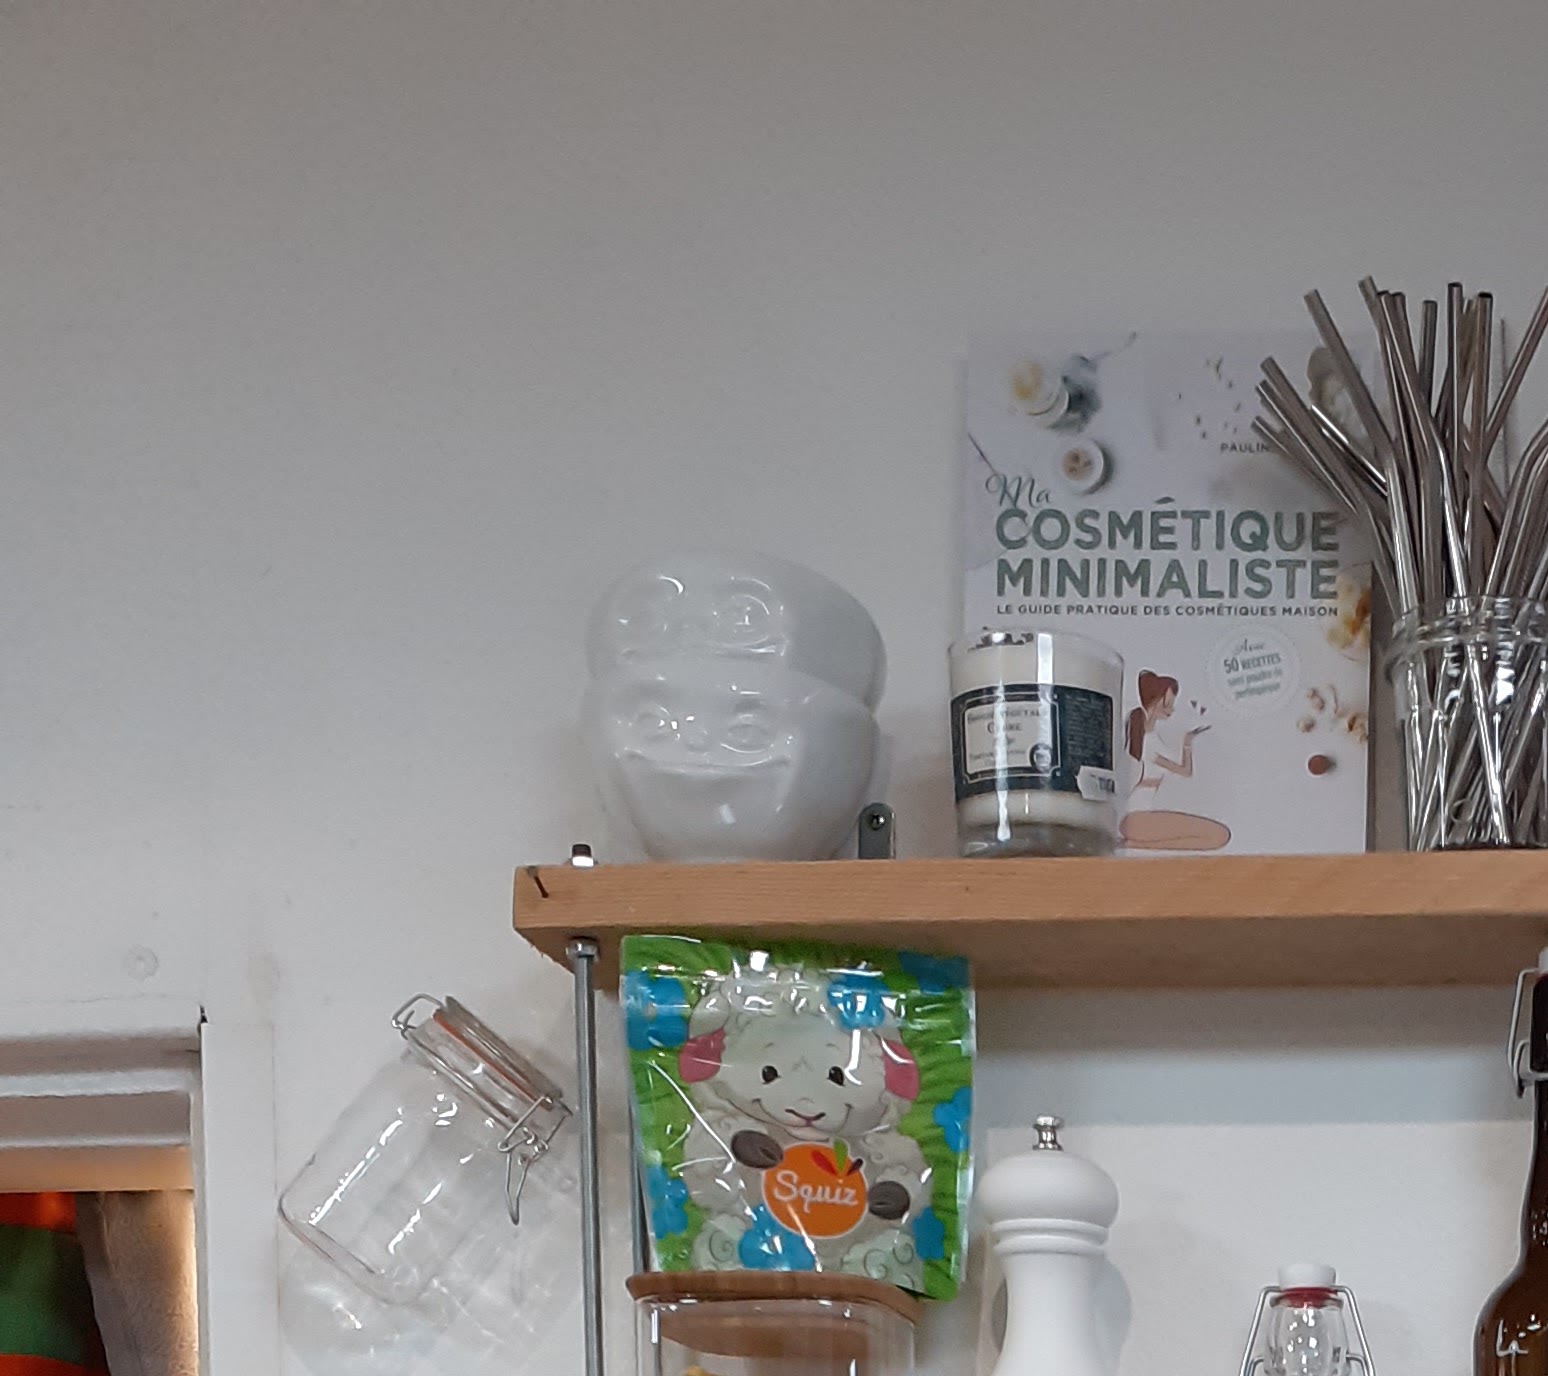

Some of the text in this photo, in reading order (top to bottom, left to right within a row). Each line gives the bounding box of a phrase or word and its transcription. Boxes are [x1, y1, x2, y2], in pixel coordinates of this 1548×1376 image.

[986, 473, 1051, 509] Ma
[995, 497, 1340, 552] COSMÉTIQUE
[996, 557, 1340, 600] MINIMALISTE
[997, 602, 1339, 617] LE GUIDE PRATIQUE DES COSMÉTIQUES MAISON
[1223, 653, 1281, 674] 50 RECETTES
[773, 1170, 859, 1214] Squiz
